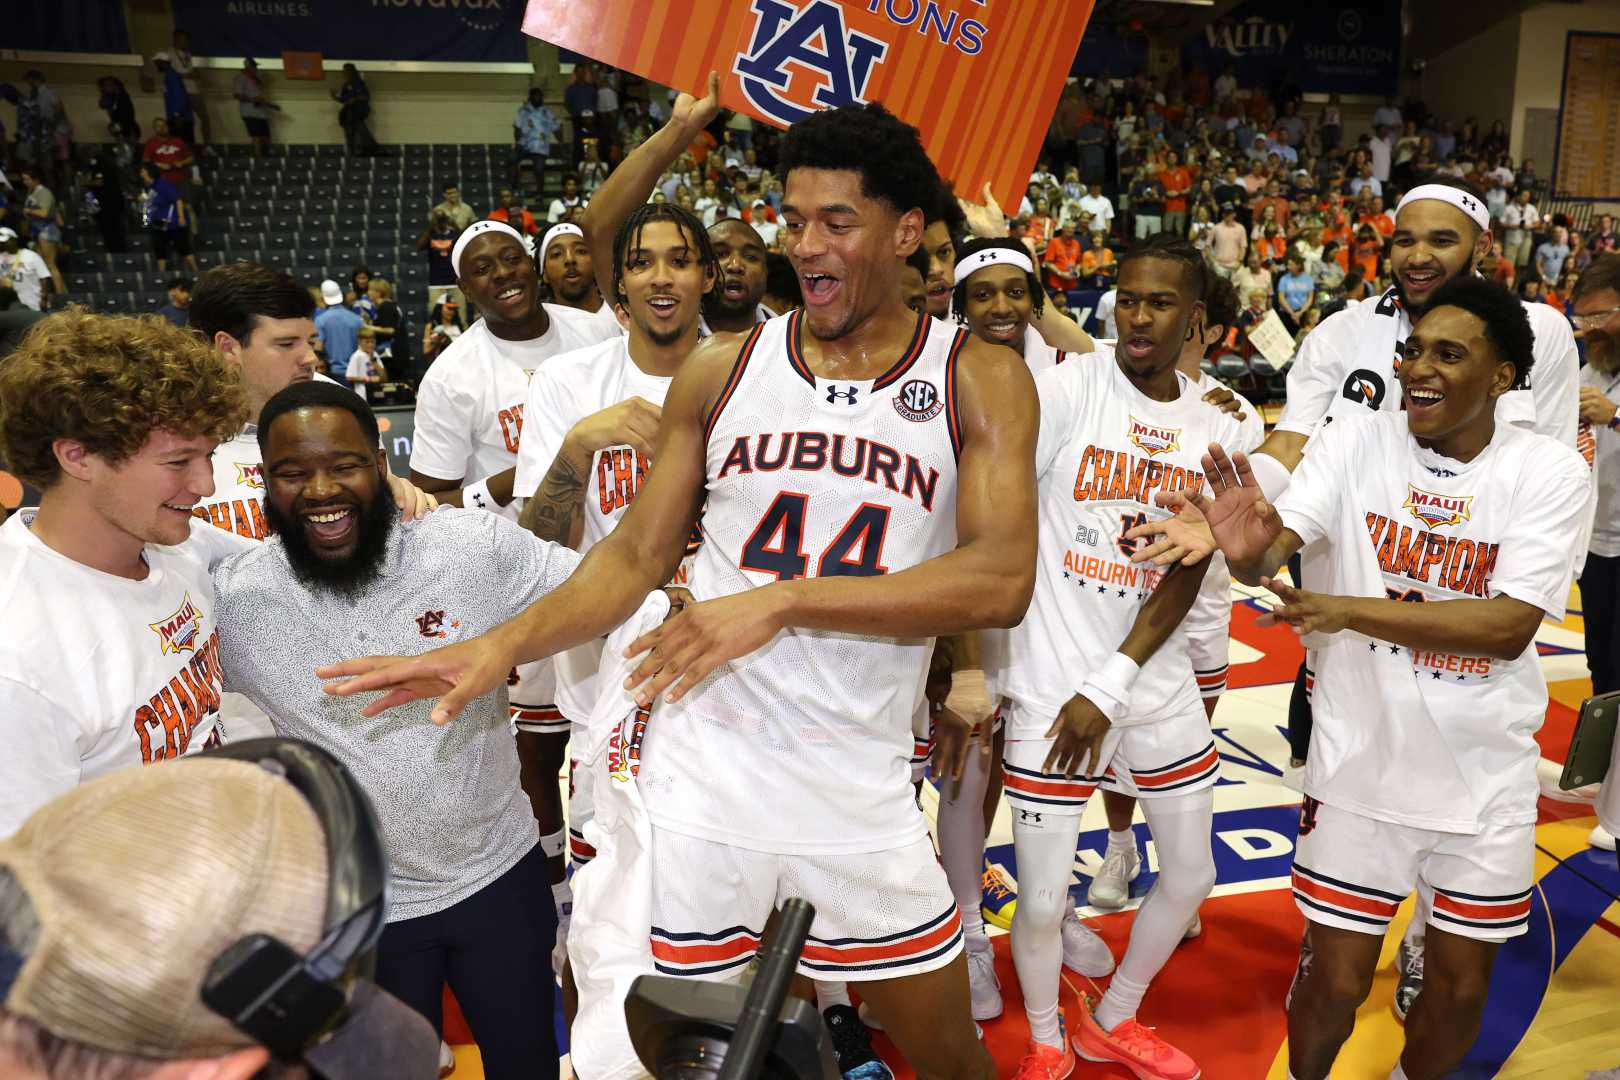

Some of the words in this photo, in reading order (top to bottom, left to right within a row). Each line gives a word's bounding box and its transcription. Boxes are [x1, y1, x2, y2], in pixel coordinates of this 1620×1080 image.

[224, 1, 309, 17] AIRLINES
[1303, 41, 1393, 64] SHERATON
[903, 381, 935, 411] SEC
[896, 403, 938, 421] GRADUATE
[1132, 422, 1176, 443] MAUI
[717, 431, 940, 513] AUBURN
[1411, 490, 1466, 513] MAUI
[739, 490, 889, 581] 44
[1063, 549, 1139, 588] AUBURN
[159, 601, 196, 643] MAUI
